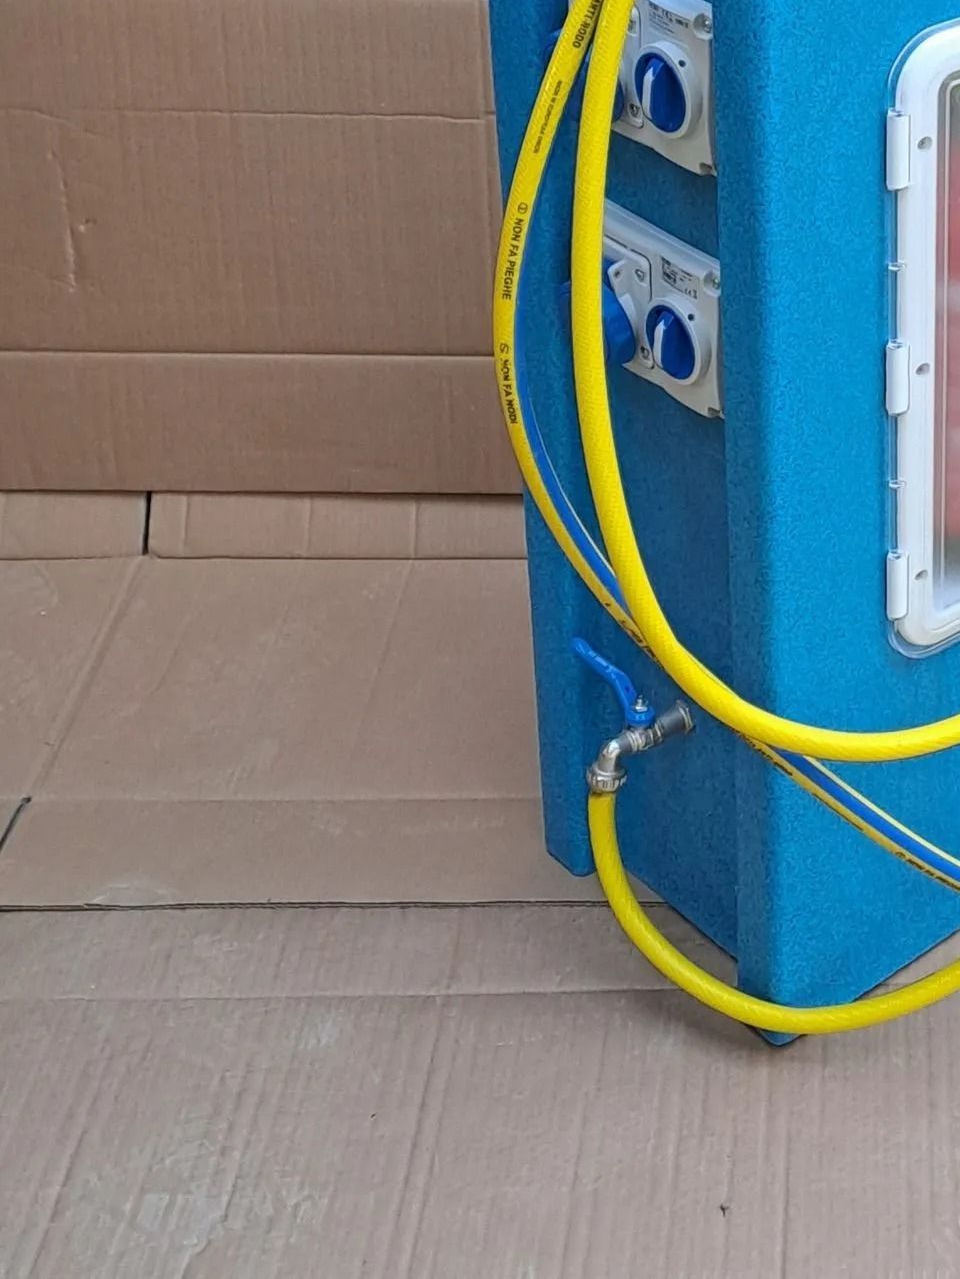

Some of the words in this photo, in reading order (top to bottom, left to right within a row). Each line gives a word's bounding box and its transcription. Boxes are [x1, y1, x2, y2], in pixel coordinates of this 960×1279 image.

[511, 217, 524, 242] NON
[508, 243, 519, 257] FA
[502, 259, 517, 301] PIEGHE
[501, 358, 510, 381] NON
[502, 384, 513, 397] FA
[505, 398, 518, 424] NODI
